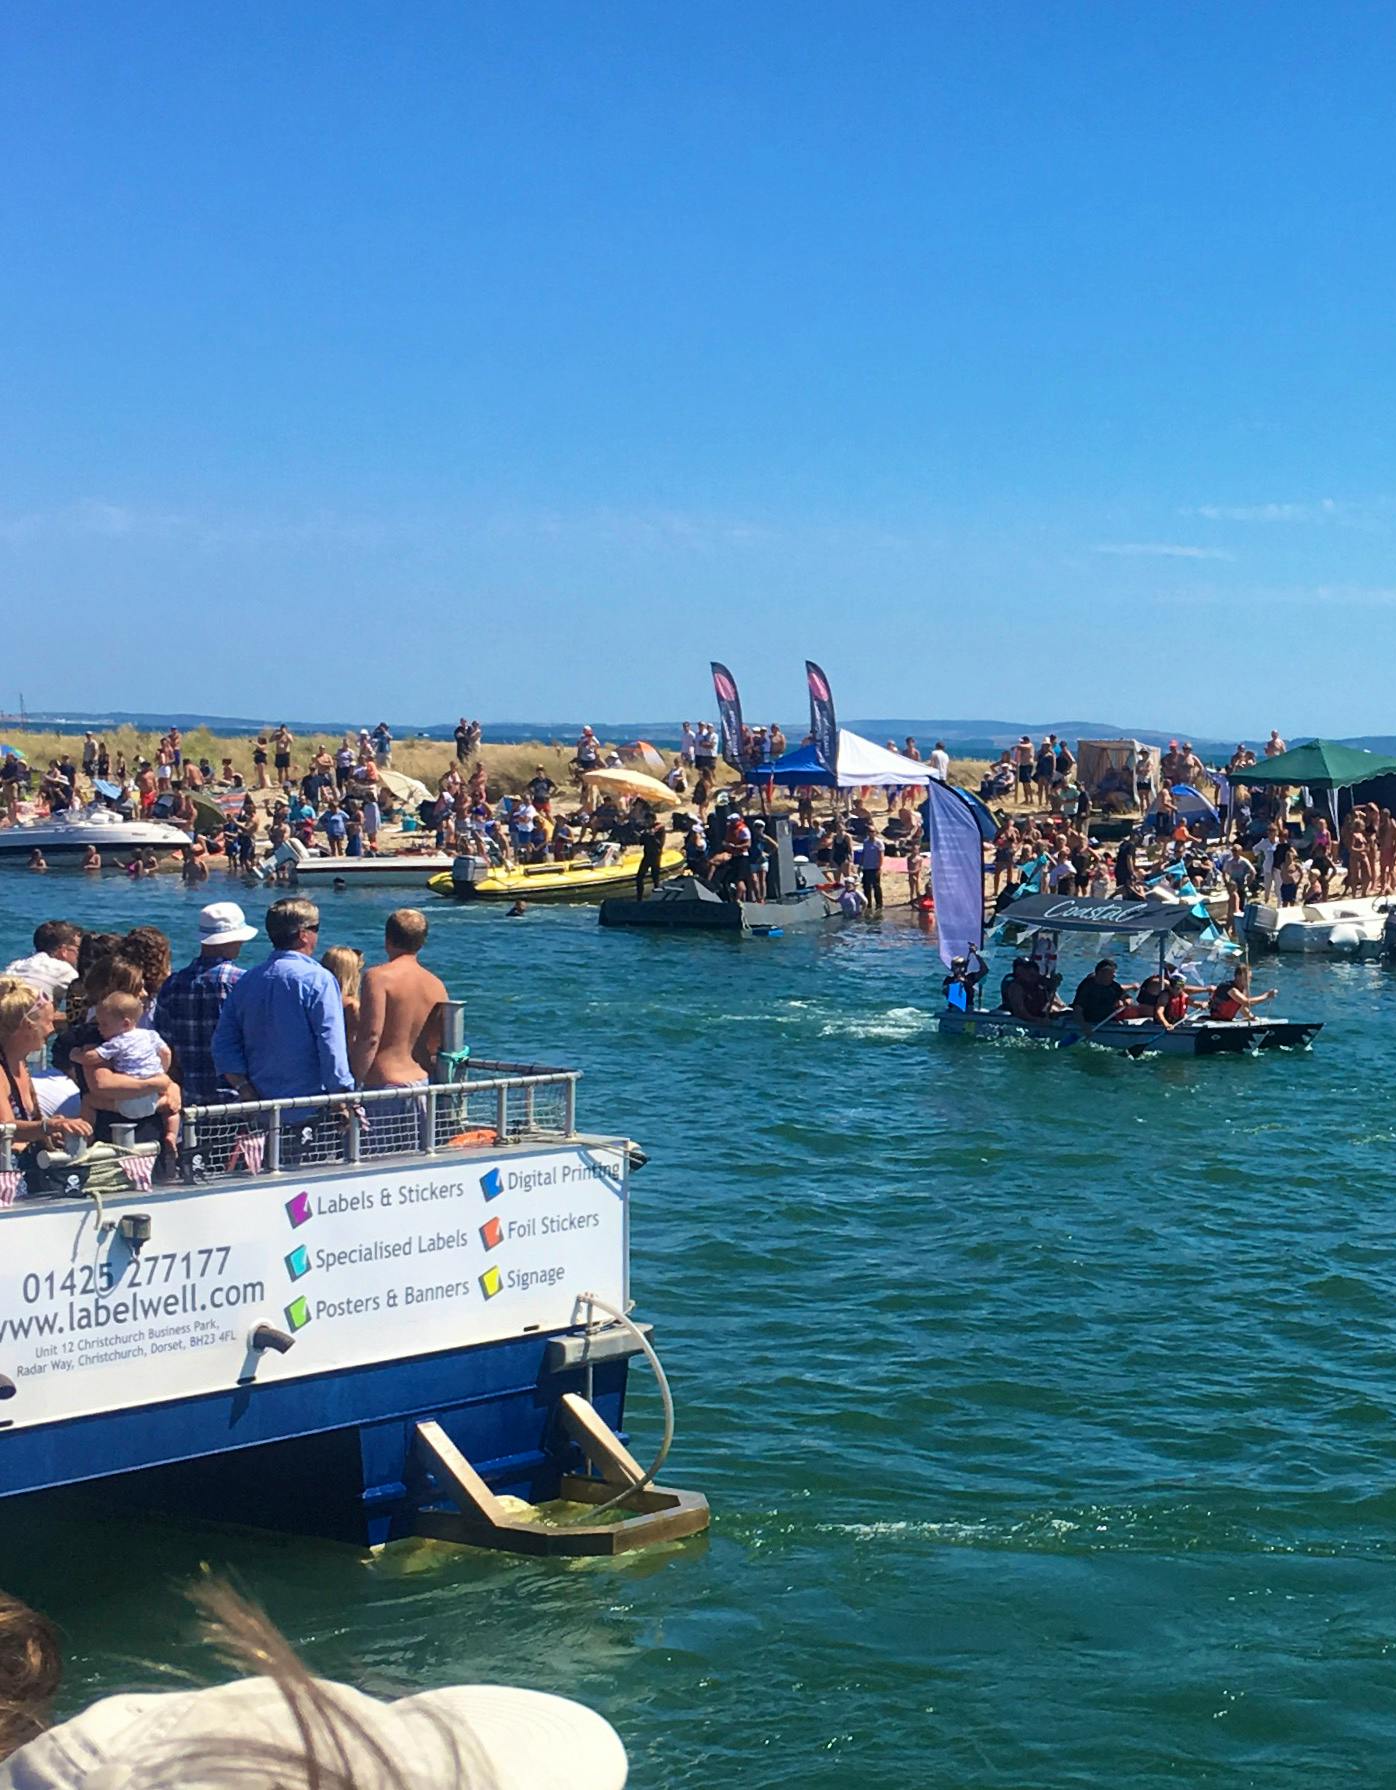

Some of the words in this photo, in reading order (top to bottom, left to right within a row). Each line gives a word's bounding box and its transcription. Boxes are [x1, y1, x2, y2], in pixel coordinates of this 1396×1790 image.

[1044, 900, 1148, 922] Coastal
[507, 1164, 557, 1192] Digital
[562, 1161, 620, 1183] Printing
[317, 1189, 374, 1216] Labels
[380, 1187, 393, 1207] &
[399, 1178, 464, 1205] Stickers
[508, 1218, 536, 1240] Foil
[541, 1210, 600, 1235] Stickers
[315, 1239, 412, 1271] Specialised
[418, 1229, 468, 1253] Labels
[22, 1262, 115, 1304] 01425
[127, 1246, 232, 1289] 277177
[507, 1264, 566, 1291] Signage
[315, 1293, 380, 1319] Posters
[386, 1288, 398, 1308] &
[405, 1277, 470, 1305] Banners
[16, 1362, 49, 1378] Radar
[51, 1357, 75, 1373] Way,
[78, 1347, 148, 1367] Christchurch,
[150, 1339, 186, 1354] Dorset,
[189, 1333, 216, 1348] BH23
[218, 1330, 237, 1344] 4FL
[35, 1344, 58, 1359] Unit
[62, 1340, 75, 1353] 12
[77, 1331, 145, 1352] Christchurch
[148, 1324, 191, 1340] Business
[194, 1319, 220, 1333] Park,
